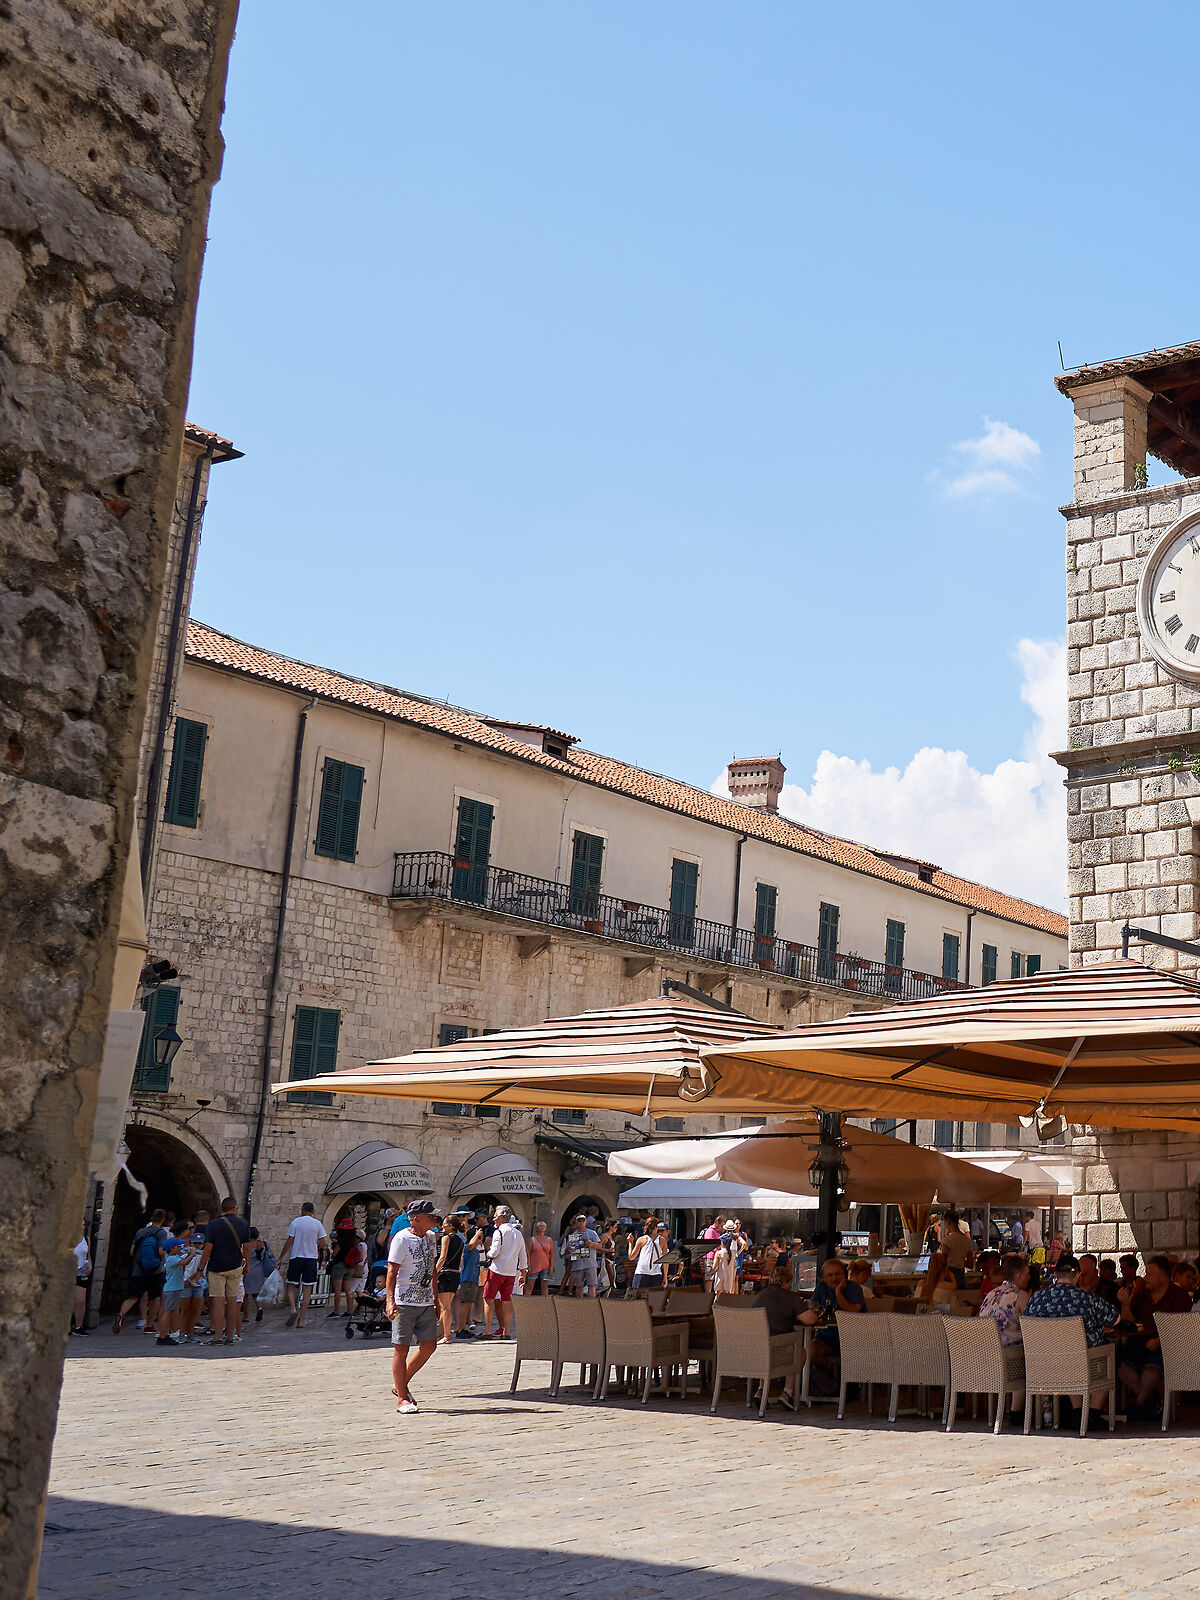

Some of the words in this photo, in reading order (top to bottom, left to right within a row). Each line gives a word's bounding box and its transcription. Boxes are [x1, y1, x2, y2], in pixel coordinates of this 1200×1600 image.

[1187, 535, 1200, 555] XI
[1168, 562, 1183, 574] X
[1160, 590, 1176, 603] IX
[1164, 614, 1183, 636] VIII
[1184, 633, 1200, 654] VII
[382, 1170, 417, 1180] SOUVENIR
[500, 1174, 525, 1183] TRAVEL
[384, 1180, 409, 1188] FORZA
